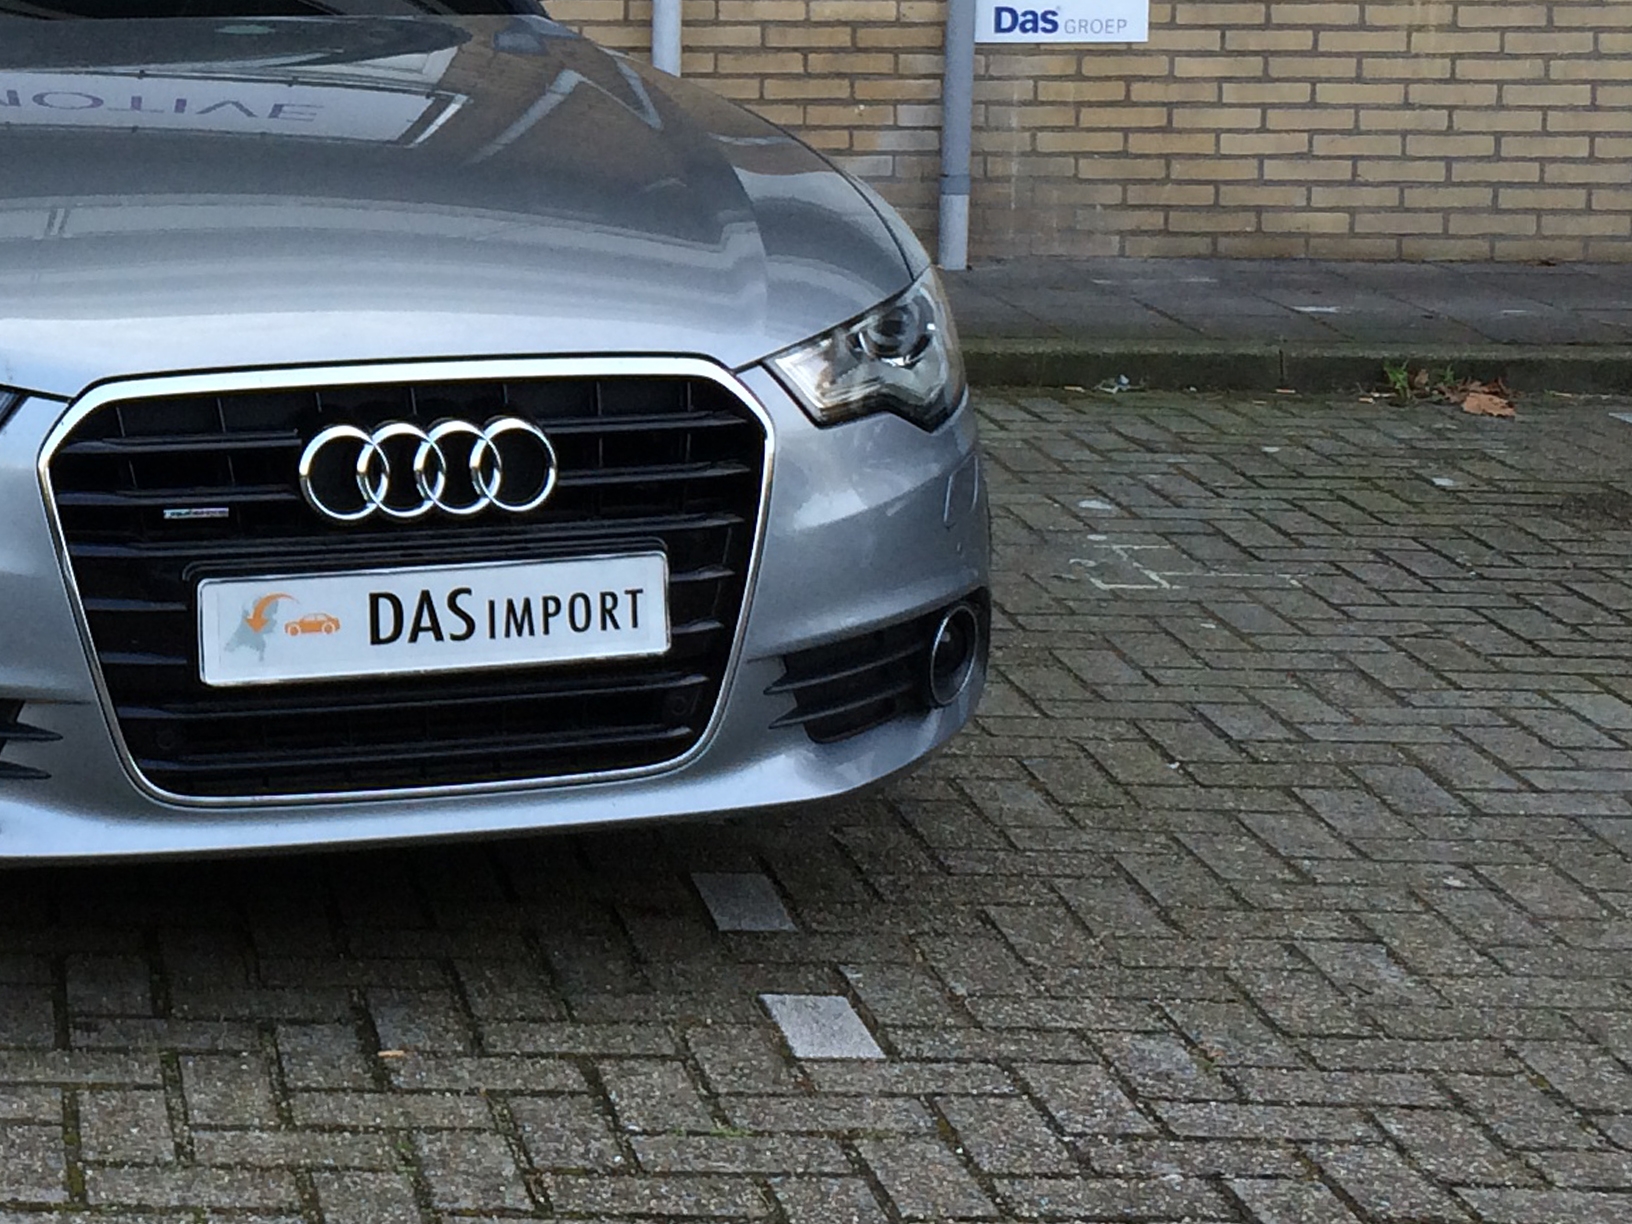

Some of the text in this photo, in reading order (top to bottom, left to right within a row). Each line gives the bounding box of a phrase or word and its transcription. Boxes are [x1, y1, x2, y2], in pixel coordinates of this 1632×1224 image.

[994, 6, 1128, 34] Das GROEP
[368, 587, 644, 645] DAS IMPORT
